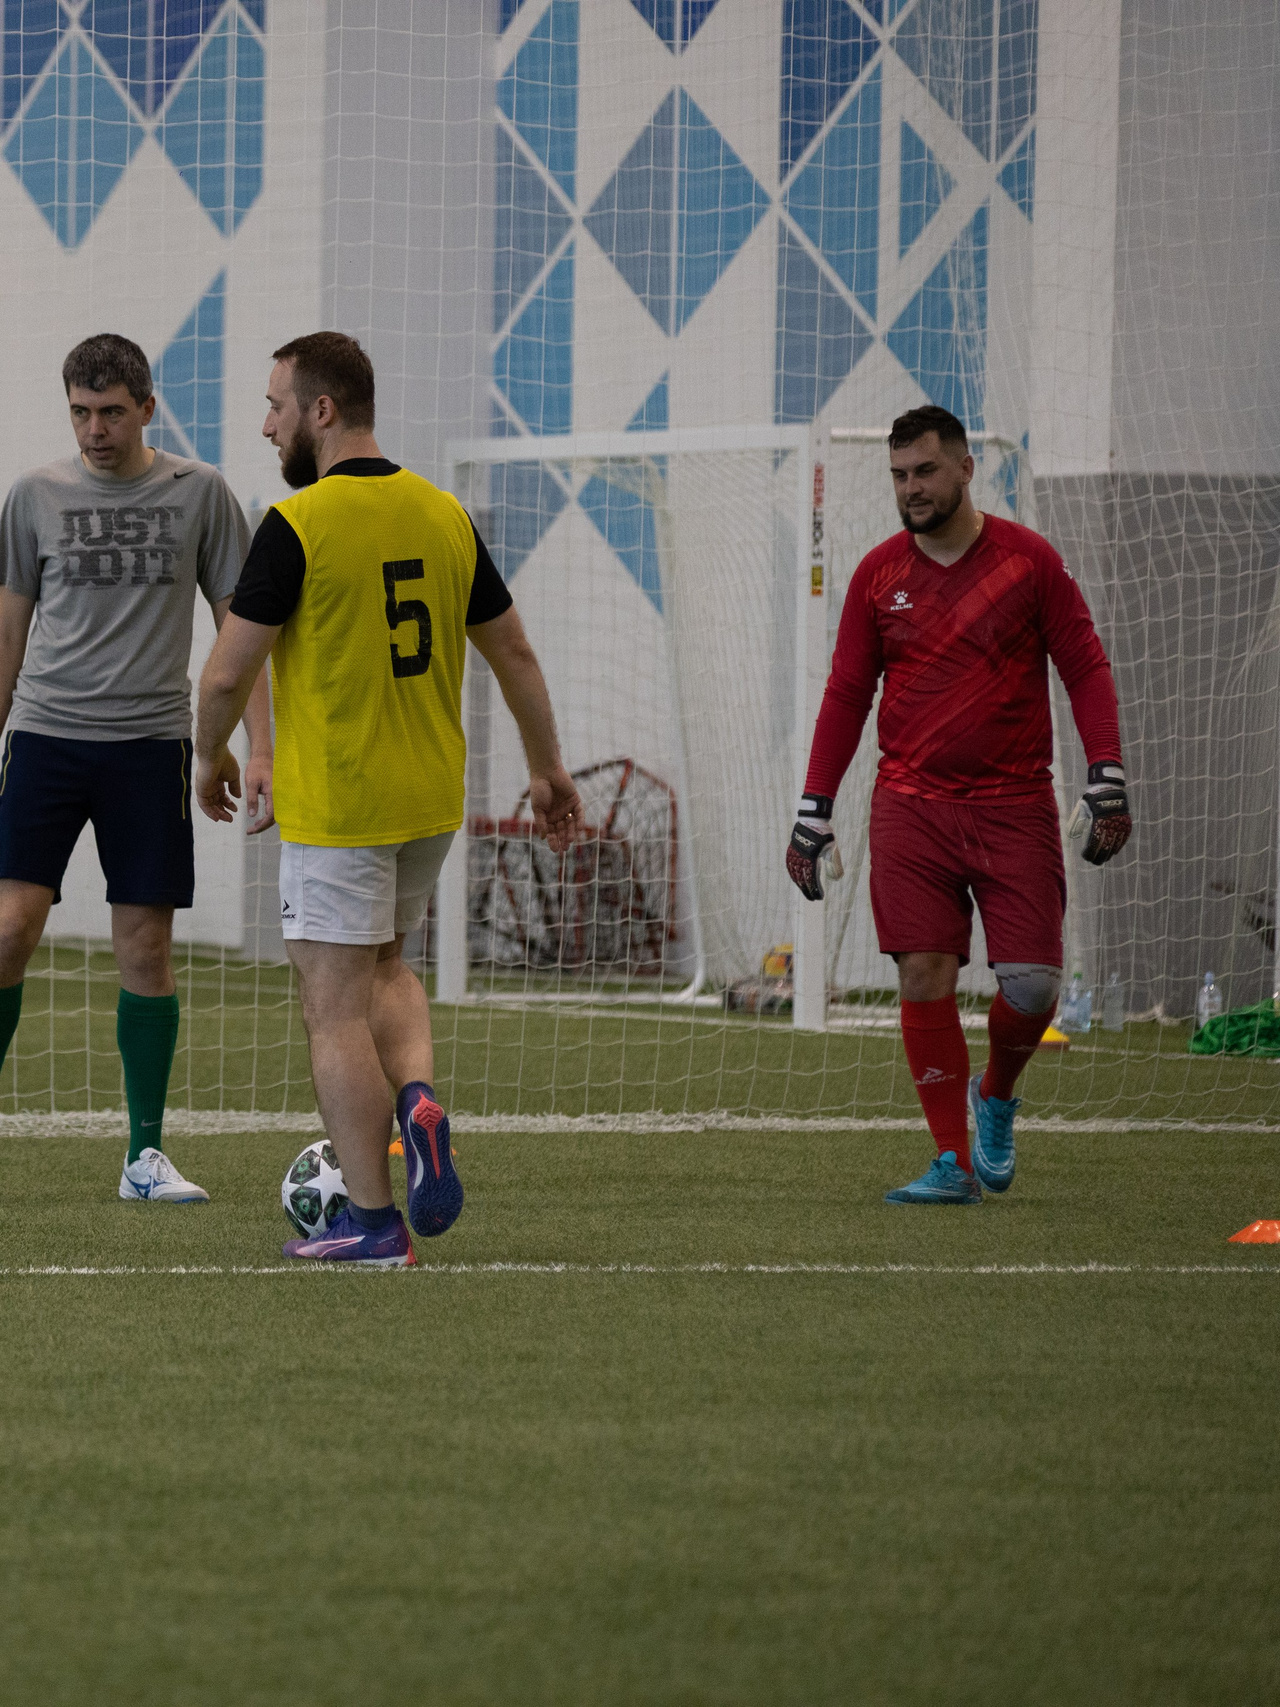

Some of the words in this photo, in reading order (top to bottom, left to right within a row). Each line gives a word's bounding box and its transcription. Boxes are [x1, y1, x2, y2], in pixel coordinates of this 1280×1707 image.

[59, 506, 183, 547] JUST
[62, 549, 123, 586] DO
[130, 548, 179, 586] IT
[382, 558, 433, 678] 5
[890, 602, 914, 611] KELME
